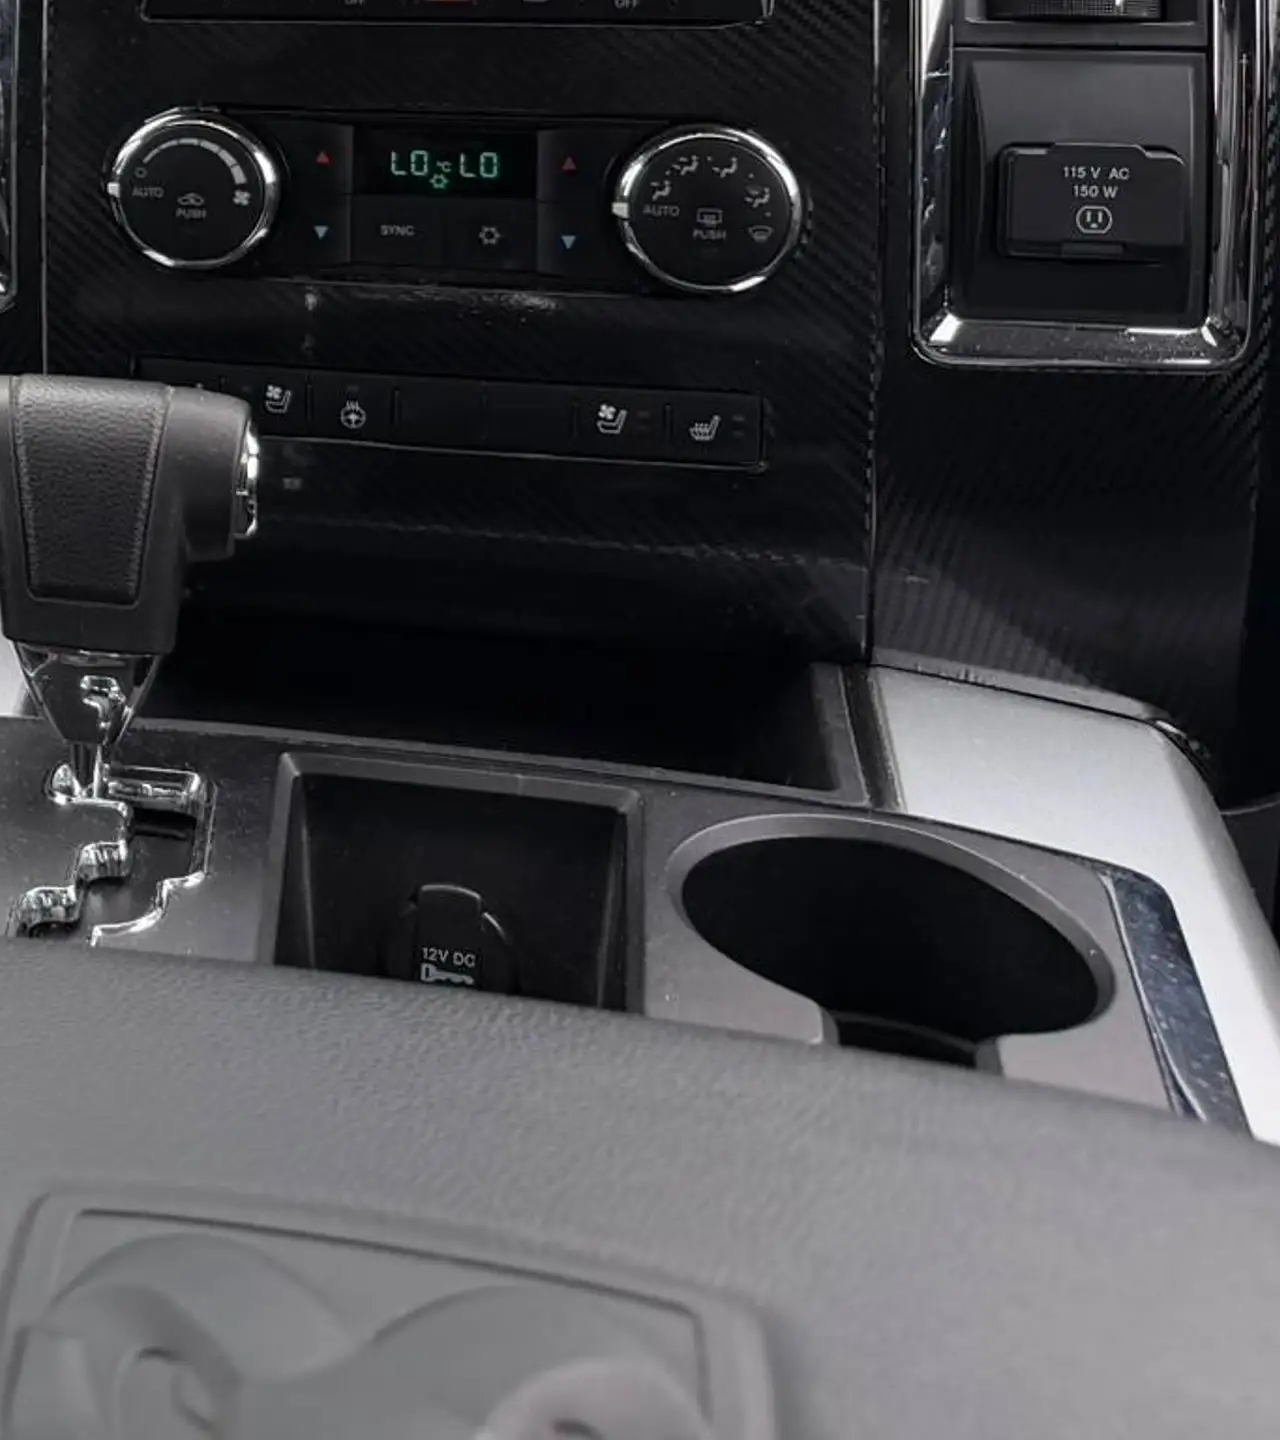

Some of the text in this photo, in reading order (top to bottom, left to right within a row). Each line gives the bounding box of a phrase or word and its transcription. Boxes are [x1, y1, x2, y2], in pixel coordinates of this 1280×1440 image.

[391, 150, 429, 177] LO
[460, 152, 500, 178] LO
[1063, 166, 1130, 180] 115 V AC
[132, 187, 165, 199] AUTO
[1073, 185, 1119, 198] 150 W
[176, 208, 207, 220] PUSH
[643, 204, 680, 217] AUTO
[380, 224, 415, 237] SYNC
[693, 229, 726, 241] PUSH
[422, 947, 477, 969] 12V DC
